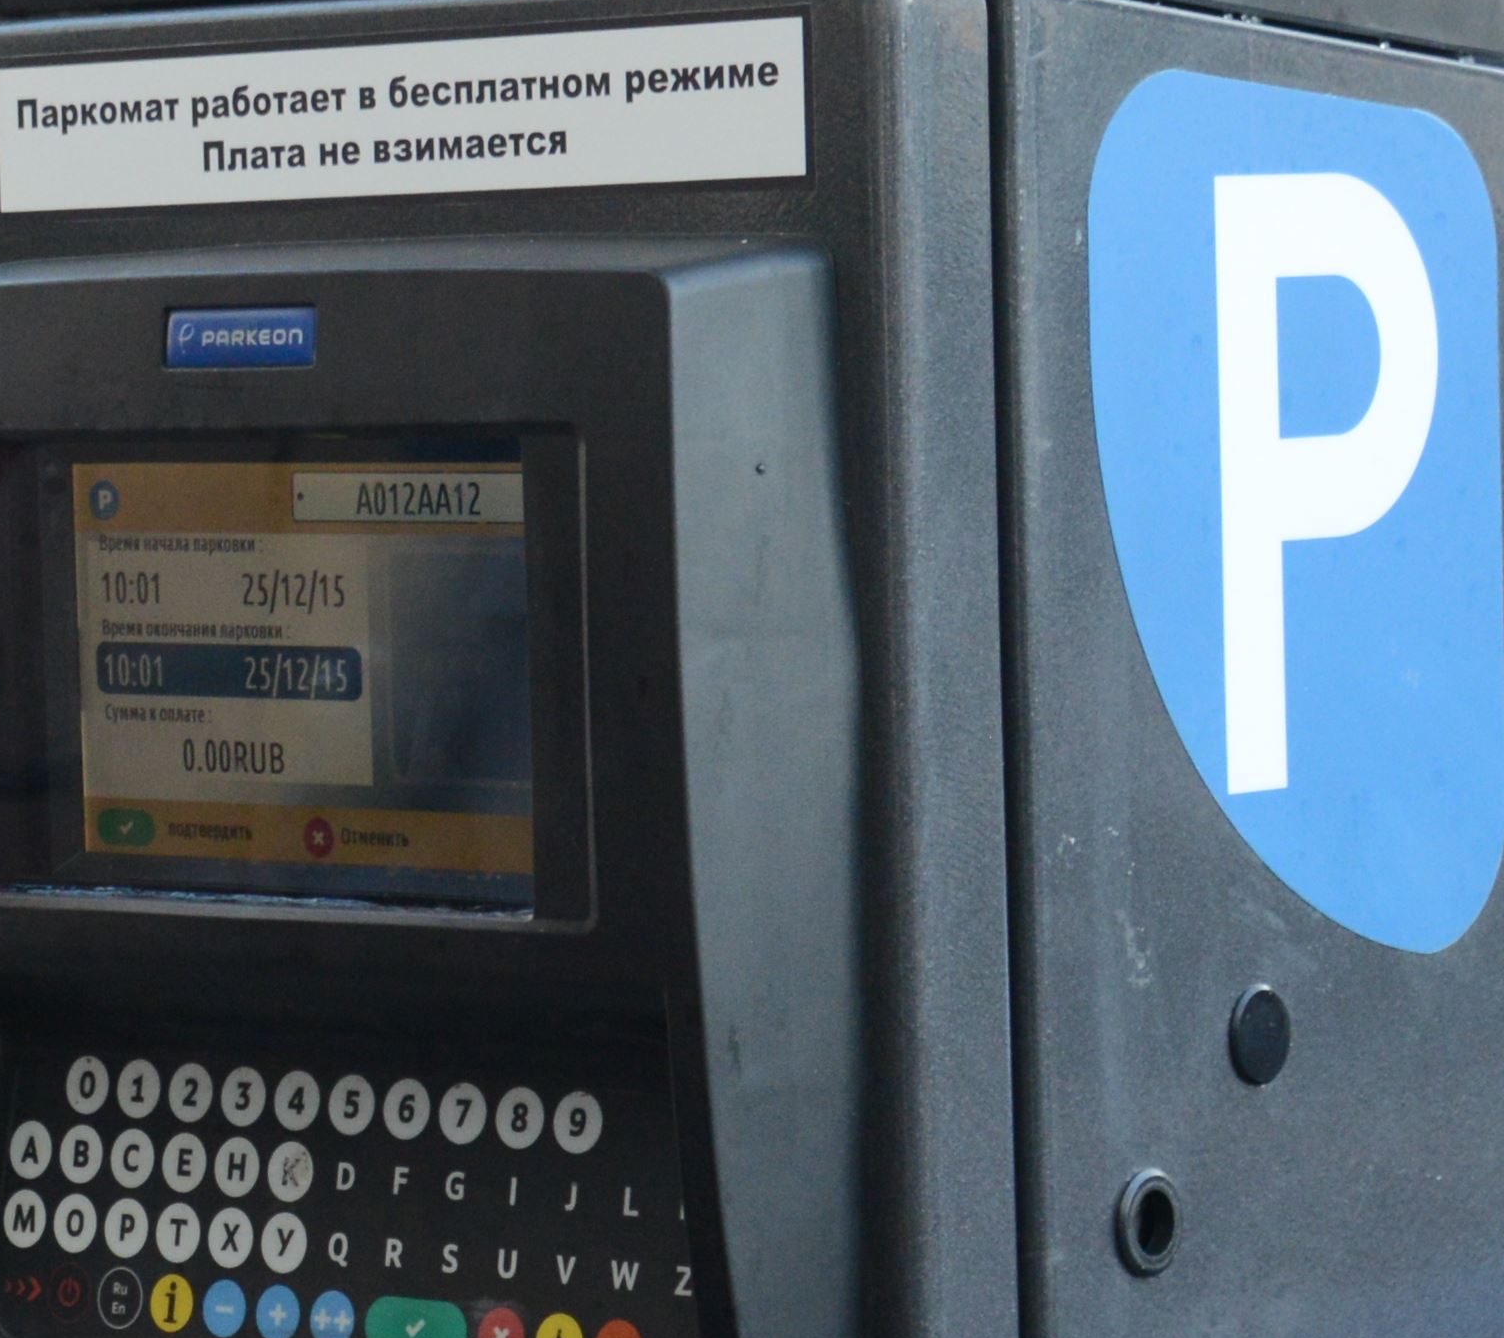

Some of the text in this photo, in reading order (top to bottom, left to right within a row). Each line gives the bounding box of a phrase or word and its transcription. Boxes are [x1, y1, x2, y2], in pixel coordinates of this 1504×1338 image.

[16, 61, 780, 136] Паркомат работает в бесплатном режиме
[202, 130, 568, 173] Плата не взимается
[202, 328, 303, 347] PARKEON
[356, 482, 481, 516] A012AA12
[1214, 172, 1439, 795] P
[99, 534, 140, 553] Время
[144, 537, 189, 551] начала
[194, 537, 255, 555] парковки
[102, 570, 345, 613] 10:01 25/12/15
[102, 619, 142, 638] Время
[146, 624, 216, 638] окончания
[220, 625, 282, 641] парковки
[104, 654, 348, 699] 10:01 25/12/15
[105, 704, 146, 723] Сумма
[149, 708, 156, 720] к
[160, 708, 205, 723] оплате
[183, 739, 285, 775] 0.00RUB
[341, 827, 410, 848] Отменить
[80, 1071, 587, 1137] 0 1 2 3 4 5 6 7 8 9
[336, 1162, 355, 1191] D
[392, 1166, 409, 1195] F
[445, 1172, 465, 1200] G
[564, 1182, 578, 1211] J
[623, 1187, 639, 1217] L
[328, 1233, 348, 1267] Q
[385, 1238, 403, 1268] R
[442, 1244, 458, 1274] S
[497, 1249, 518, 1279] U
[557, 1255, 576, 1285] V
[611, 1260, 639, 1291] W
[674, 1266, 692, 1296] Z
[112, 1282, 128, 1295] Ru
[111, 1302, 126, 1314] En
